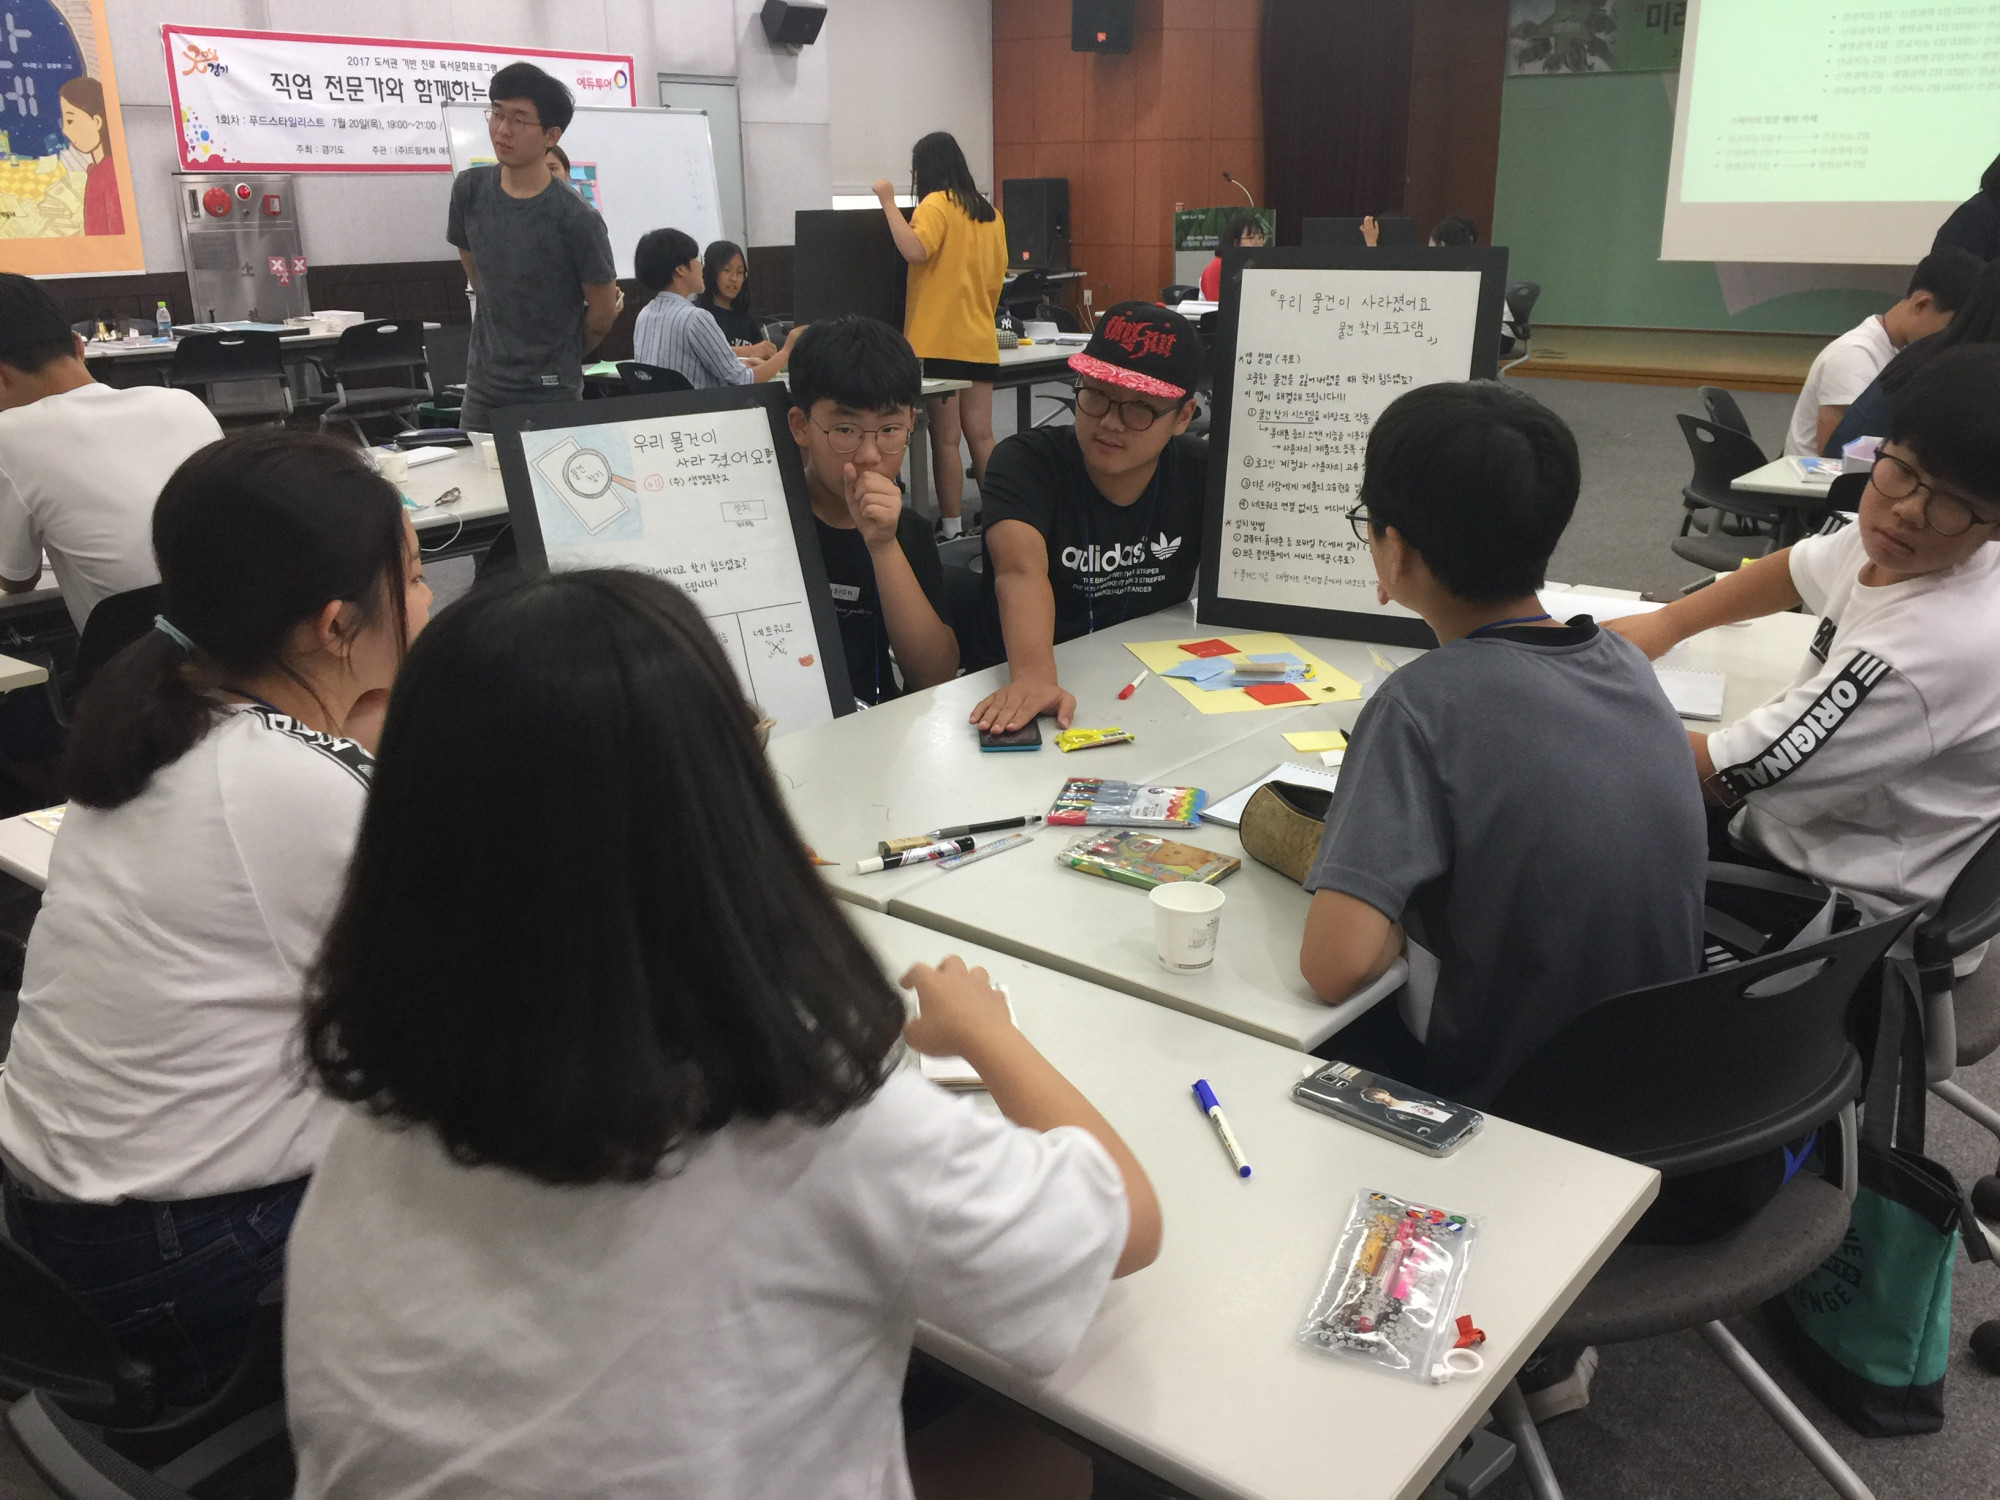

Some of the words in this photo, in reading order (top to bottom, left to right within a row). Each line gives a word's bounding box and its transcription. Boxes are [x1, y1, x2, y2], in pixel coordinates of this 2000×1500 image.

[347, 56, 370, 67] 2017
[374, 57, 398, 69] 도서관
[402, 58, 417, 70] 기반
[421, 59, 436, 70] 진로
[270, 72, 313, 101] 직업
[325, 75, 404, 103] 전문가와
[413, 78, 488, 103] 함께하는
[576, 77, 612, 91] 에듀투어
[216, 114, 240, 126] 1회차
[249, 115, 325, 128] 푸드스타일리스트
[331, 118, 346, 130] 7월
[322, 144, 345, 155] 경기도
[372, 145, 387, 155] 주관
[1313, 292, 1350, 315] 물건이
[1362, 293, 1431, 313] 사라졌어요
[1338, 321, 1354, 339] 물건
[1359, 320, 1379, 336] 찾기
[1273, 373, 1294, 387] 물건을
[1361, 373, 1376, 385] 찾기
[1276, 392, 1303, 404] 해결해
[633, 434, 664, 454] 우리
[670, 428, 718, 453] 물건이
[1325, 430, 1344, 442] 기능을
[1315, 444, 1341, 456] 제품으로
[1254, 457, 1276, 470] 로그인
[1311, 461, 1343, 473] 사용자의
[1345, 462, 1359, 472] 고유
[1252, 479, 1264, 491] 다른
[1267, 480, 1299, 493] 사람에게
[1302, 481, 1324, 493] 제품의
[1251, 501, 1278, 511] 네트워크
[1298, 502, 1319, 514] 없이도
[1295, 538, 1316, 548] 모바일
[1061, 543, 1146, 573] adidas
[1293, 553, 1314, 561] 서비스
[690, 561, 707, 574] 찾기
[753, 622, 794, 637] 네트워크
[1734, 679, 1858, 788] ORIGINAL
